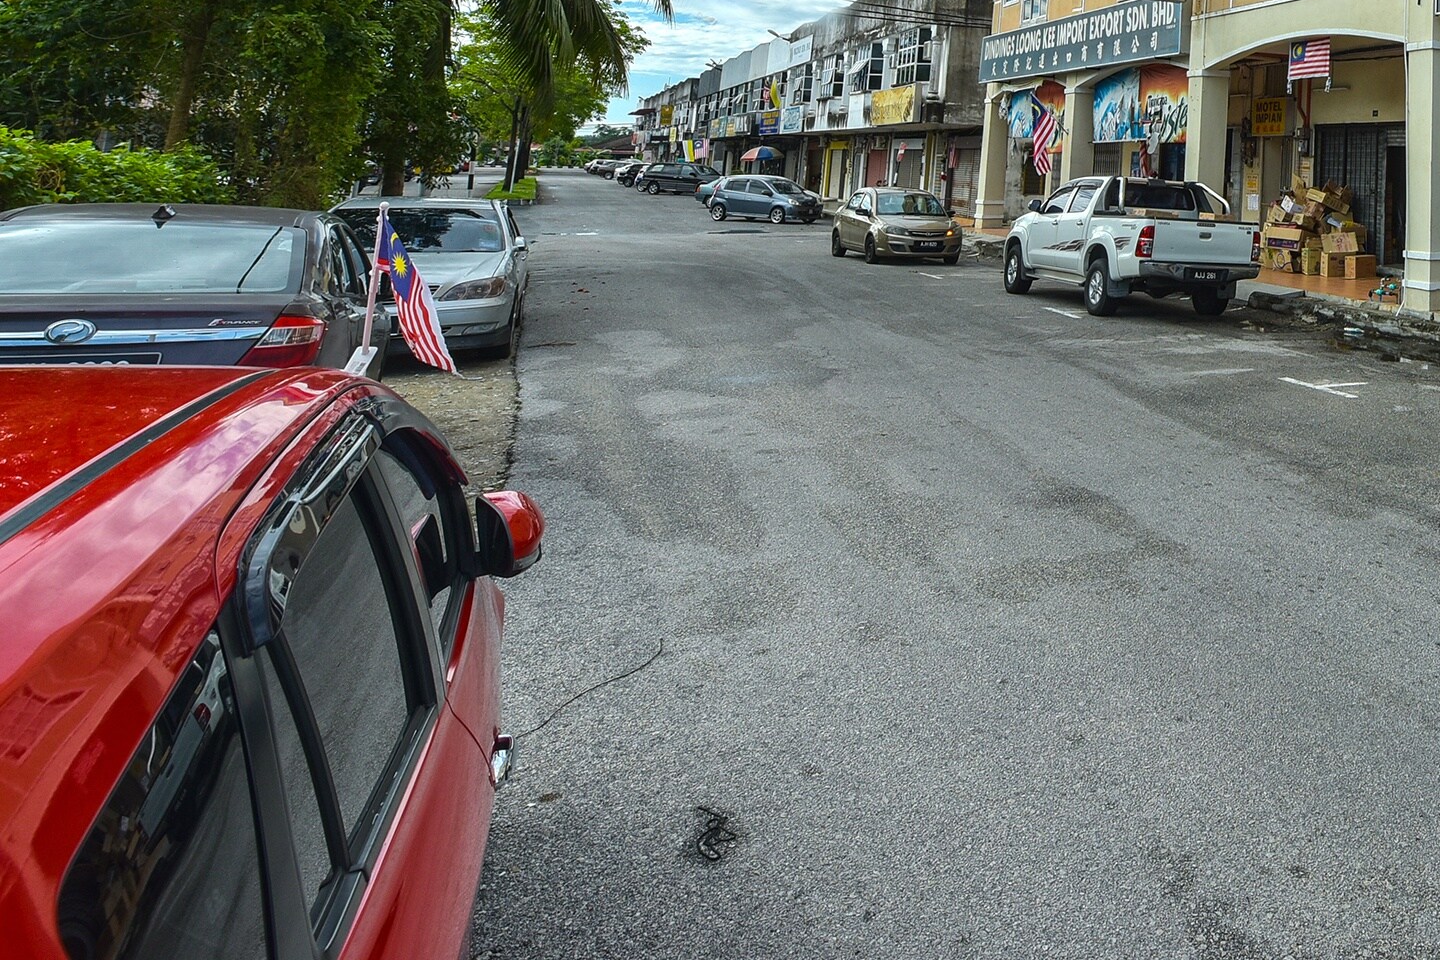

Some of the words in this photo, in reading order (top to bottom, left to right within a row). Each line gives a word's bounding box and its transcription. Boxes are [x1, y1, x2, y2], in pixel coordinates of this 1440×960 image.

[984, 35, 1015, 60] DINDINGS
[1015, 29, 1041, 55] LOONG
[1042, 25, 1056, 50] KEE
[1056, 18, 1088, 47] IMPORT
[1089, 9, 1124, 40] EXPORT
[1126, 3, 1149, 33] SDN.
[1151, 0, 1176, 27] BHD.
[1256, 101, 1282, 112] MOTEL
[1256, 112, 1282, 124] IMPIAN
